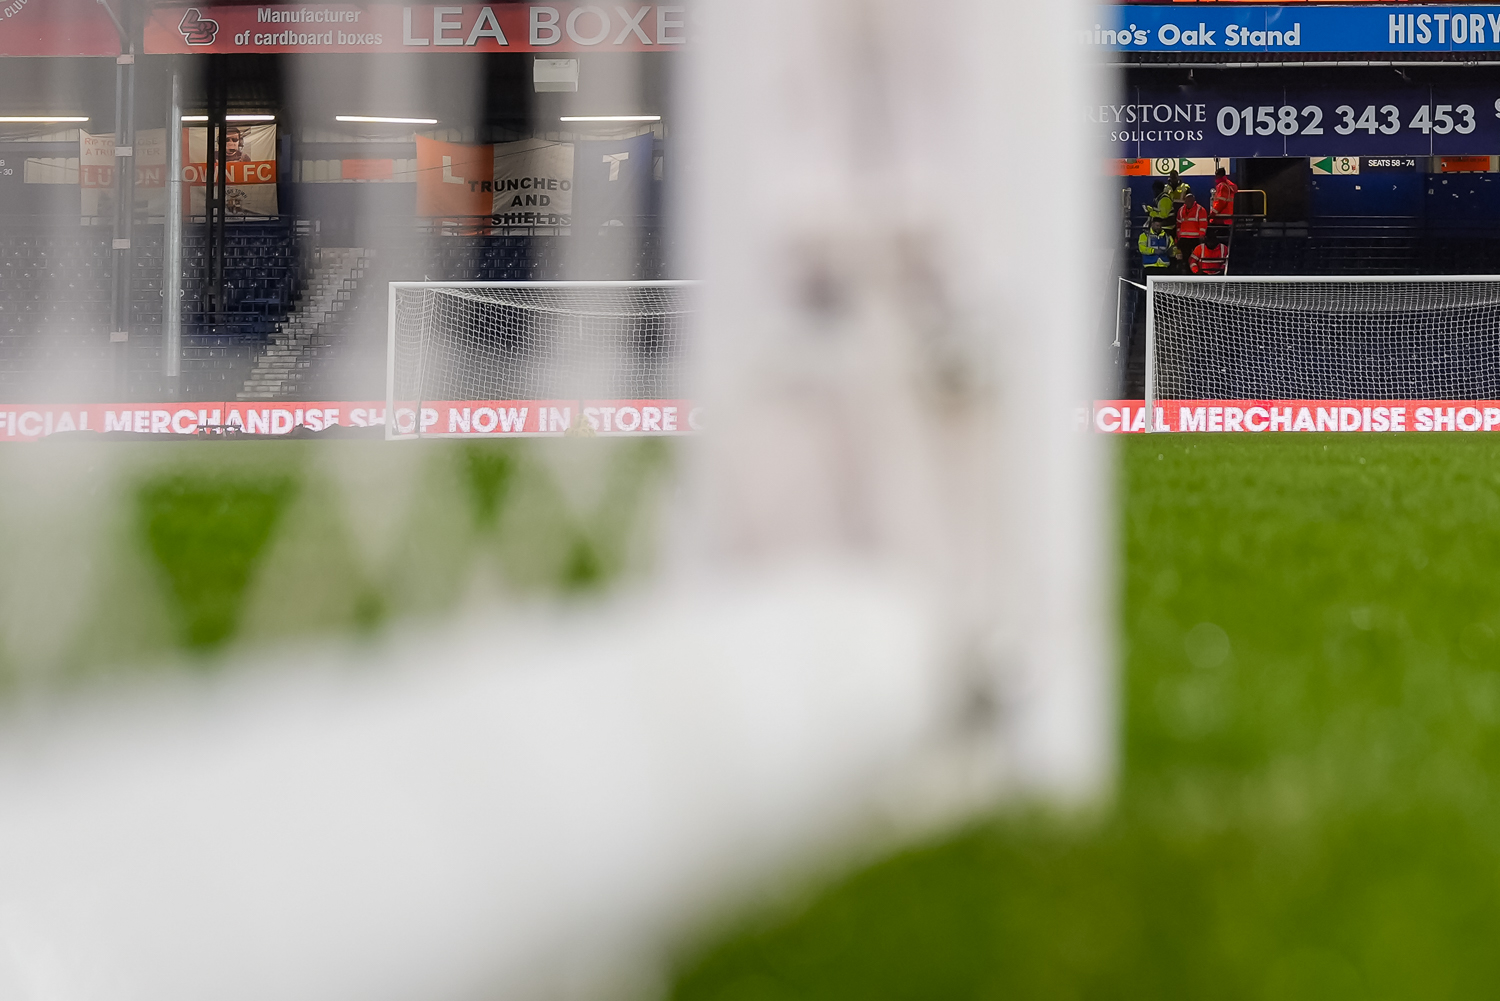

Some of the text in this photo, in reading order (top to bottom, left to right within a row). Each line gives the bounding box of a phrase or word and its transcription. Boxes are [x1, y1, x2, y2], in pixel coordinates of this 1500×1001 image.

[257, 8, 361, 24] Manufacturer
[402, 5, 690, 47] LEA BOXE
[1158, 23, 1216, 46] Oak
[1225, 23, 1301, 46] Stand
[234, 29, 383, 46] of cardboard boxes
[1085, 104, 1206, 123] REYSTONE
[1216, 104, 1477, 136] 01582 343 453
[1110, 130, 1204, 142] SOLICITORS
[442, 156, 465, 184] L
[602, 152, 629, 182] T
[1368, 159, 1390, 167] SEATS
[1391, 159, 1401, 167] 58
[1406, 159, 1415, 167] 74
[243, 164, 272, 182] FC
[468, 177, 572, 192] TRUNCHEO
[511, 195, 551, 207] AND
[491, 213, 572, 226] SHIELDS
[105, 408, 339, 435] MERCHANDISE
[349, 407, 438, 433] SHOP
[449, 407, 529, 433] NOW
[539, 406, 571, 432] IN
[583, 406, 677, 432] STORE
[1180, 406, 1406, 432] MERCHANDISE
